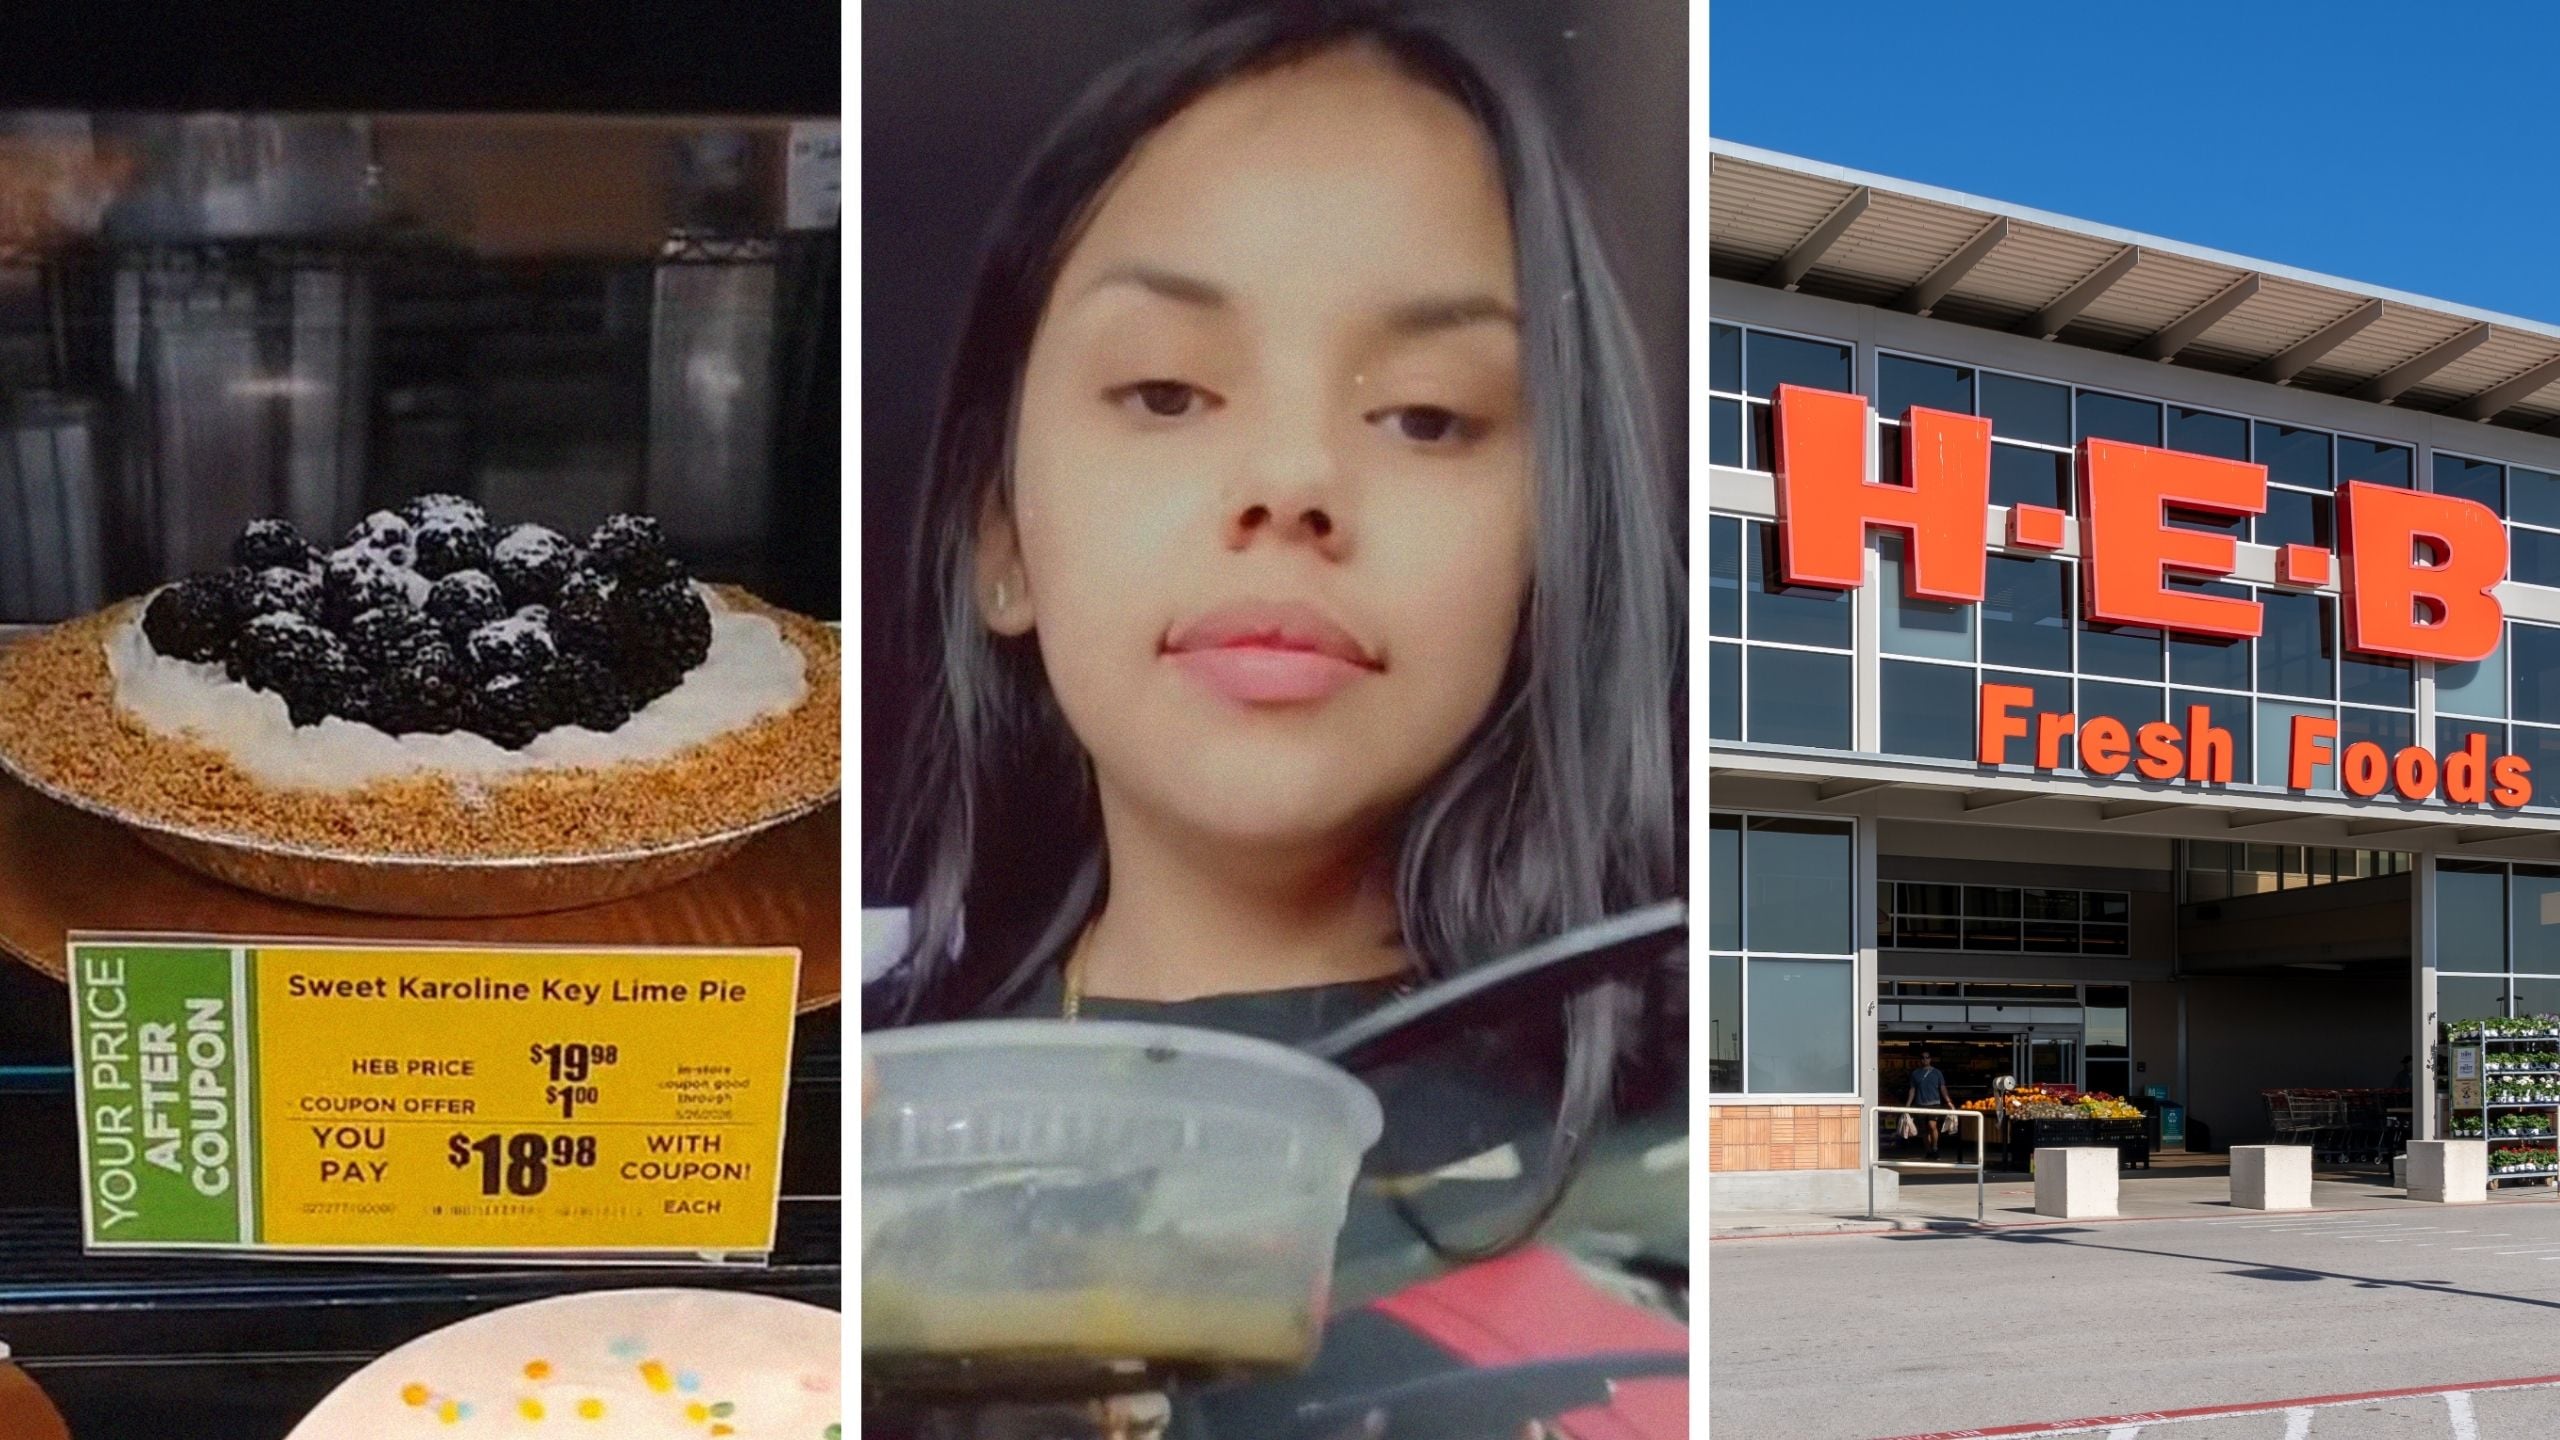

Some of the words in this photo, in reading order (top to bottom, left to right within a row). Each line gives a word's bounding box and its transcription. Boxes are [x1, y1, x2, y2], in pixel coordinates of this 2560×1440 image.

[1977, 682, 2234, 784] Fresh
[2289, 714, 2533, 810] Foods
[289, 974, 387, 998] Sweet
[399, 976, 530, 1000] Karoline
[542, 978, 601, 1006] Key
[612, 979, 688, 1002] Lime
[699, 979, 747, 1003] Pie
[85, 957, 132, 1090] PRICE
[352, 1058, 399, 1076] HEB
[406, 1059, 476, 1077] PRICE
[138, 1021, 183, 1174] AFTER
[184, 997, 230, 1196] COUPON
[300, 1096, 396, 1113] COUPON
[403, 1098, 476, 1115] OFFER
[312, 1126, 386, 1150] YOU
[646, 1134, 722, 1154] WITH
[95, 1105, 139, 1230] YOUR
[320, 1160, 389, 1183] PAY
[619, 1161, 752, 1182] COUPON!
[663, 1199, 722, 1215] EACH
